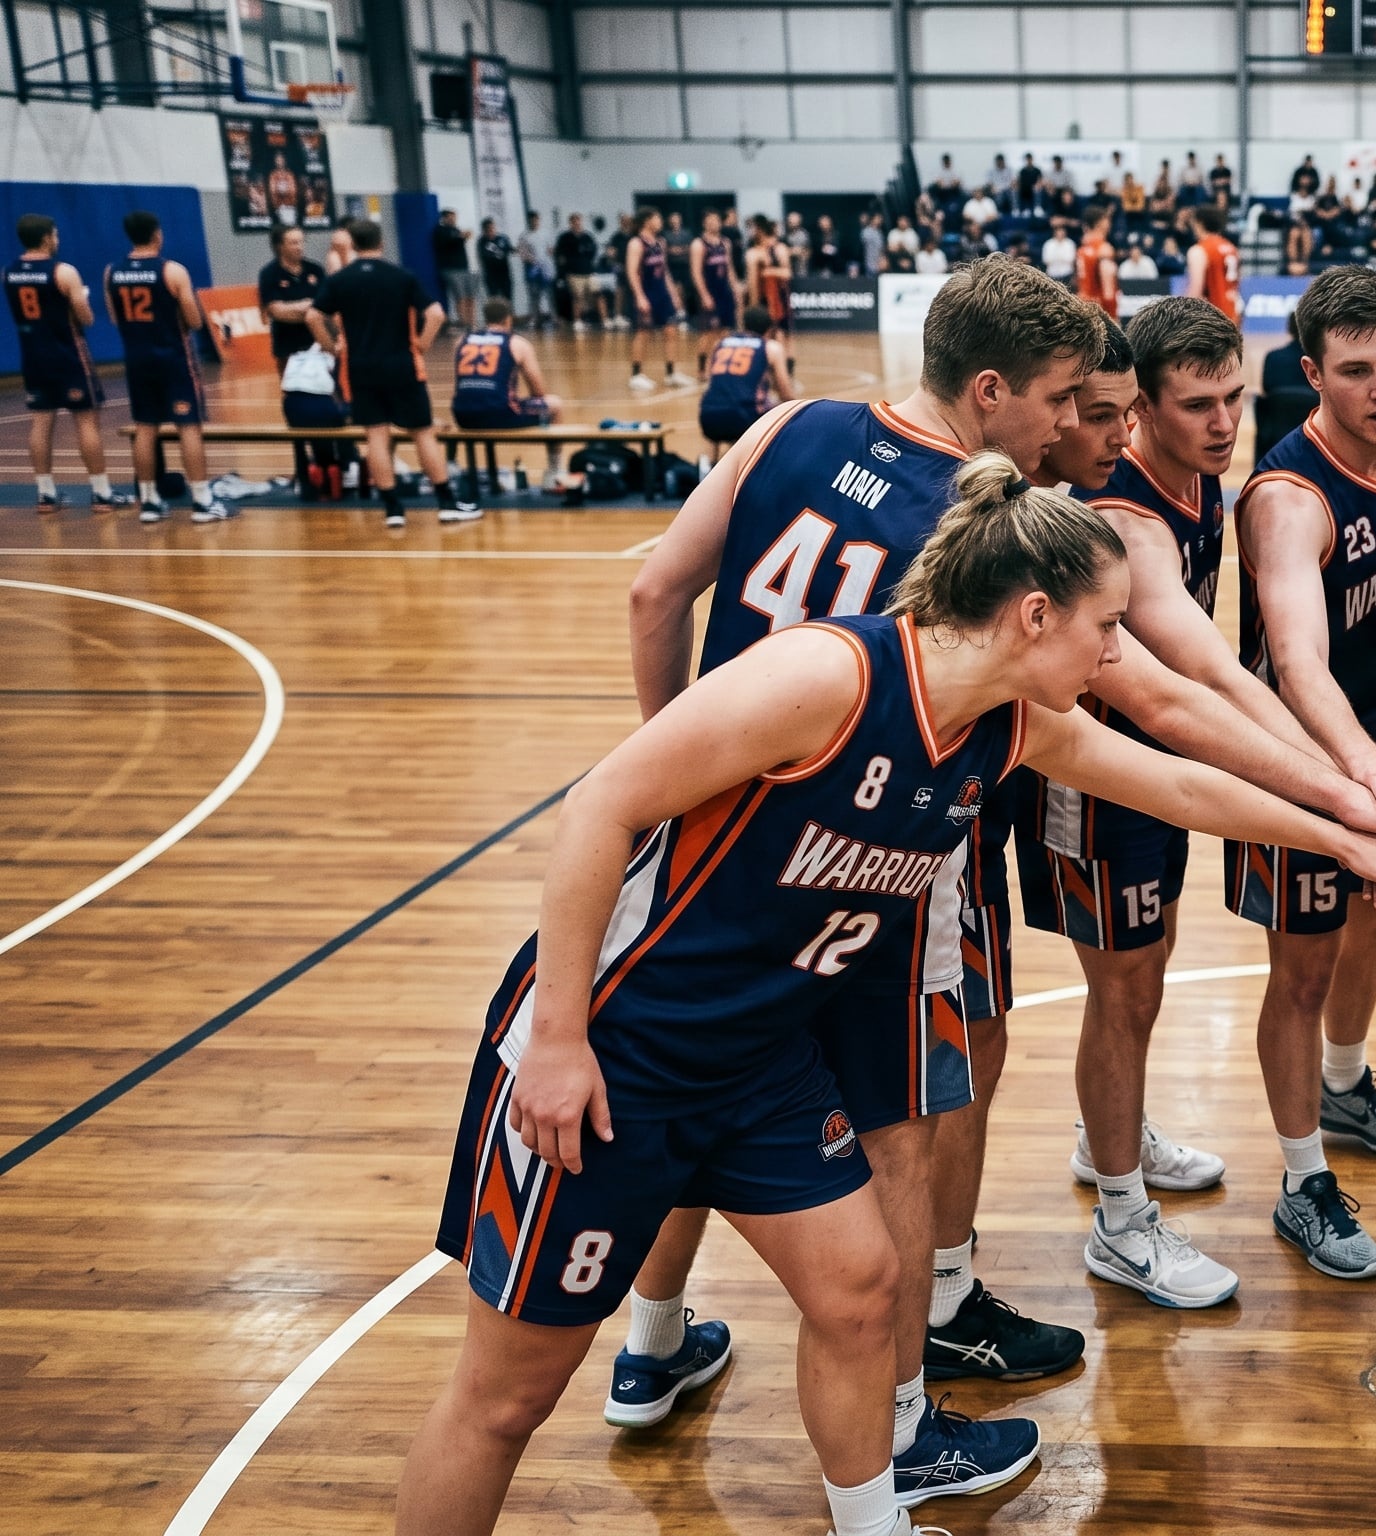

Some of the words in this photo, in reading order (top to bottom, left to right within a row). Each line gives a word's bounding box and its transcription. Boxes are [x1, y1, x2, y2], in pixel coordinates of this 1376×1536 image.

[119, 286, 154, 322] 12
[459, 344, 500, 376] 23
[1343, 515, 1376, 563] 23
[740, 507, 889, 632] 41
[853, 755, 893, 811] 8
[777, 820, 953, 899] WARRIOR
[1121, 879, 1161, 929] 15
[1295, 871, 1338, 914] 15
[791, 909, 881, 978] 12
[559, 1229, 615, 1294] 8
